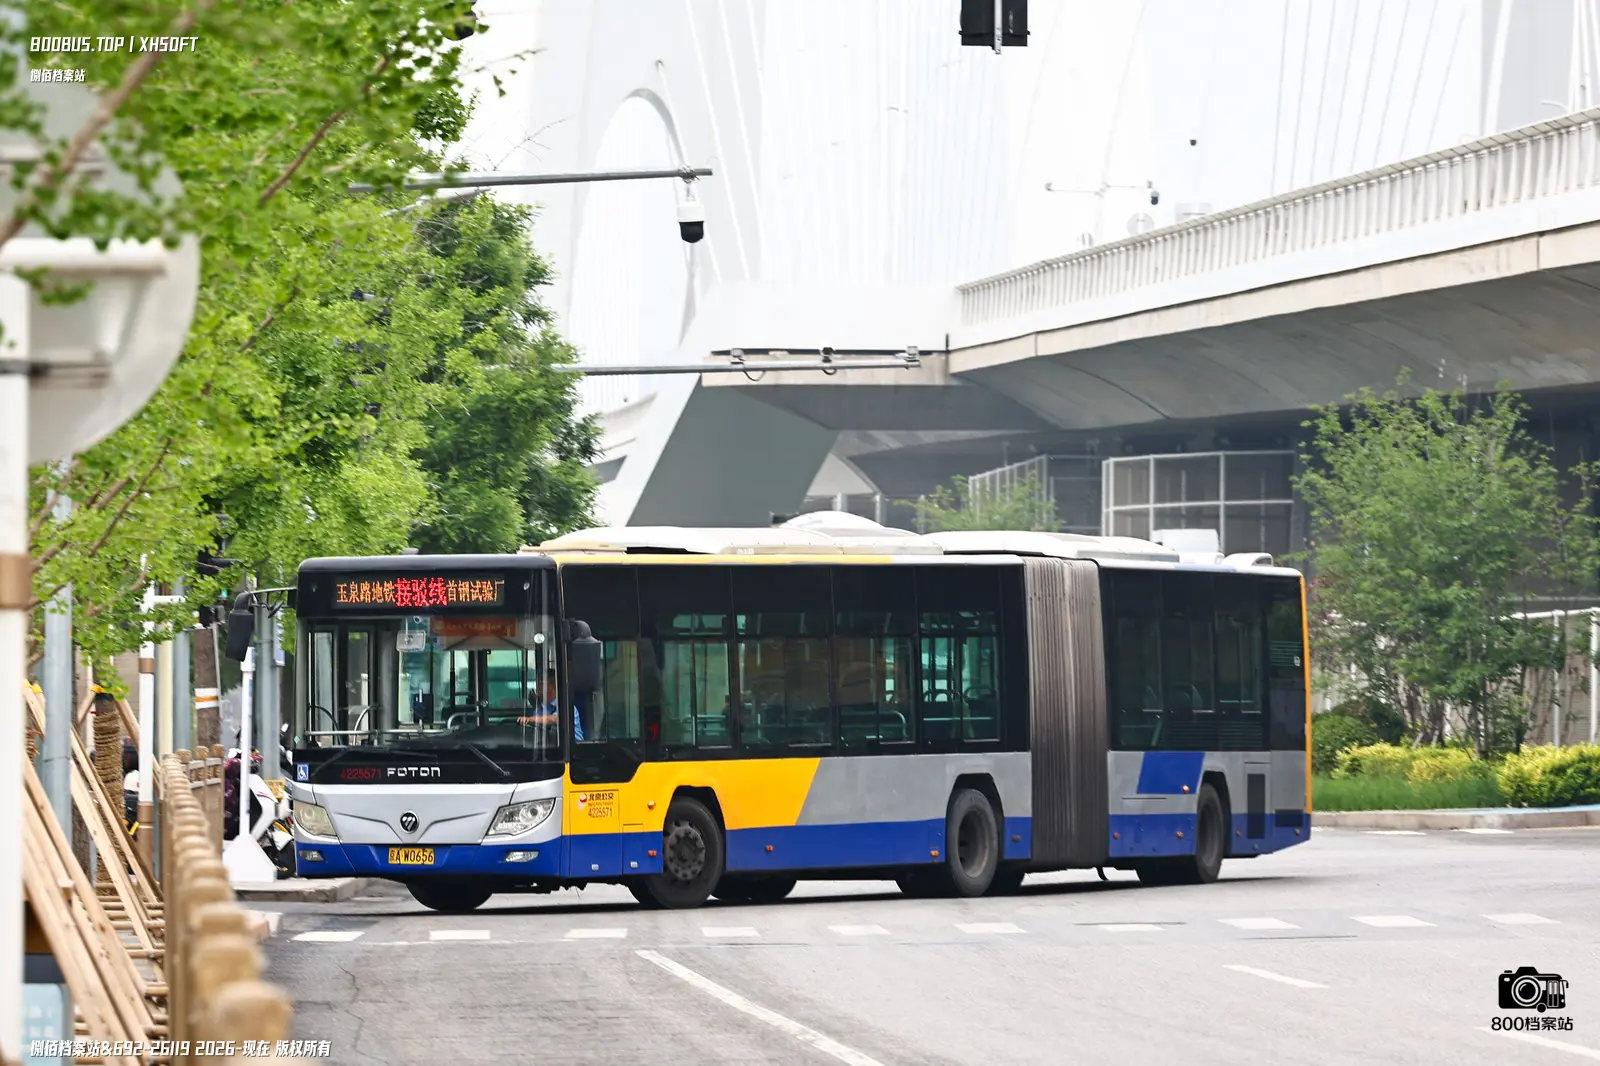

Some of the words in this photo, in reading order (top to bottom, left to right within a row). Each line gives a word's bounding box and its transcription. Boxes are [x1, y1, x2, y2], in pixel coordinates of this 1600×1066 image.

[340, 767, 382, 780] 4225571
[387, 766, 441, 778] FOTON
[588, 807, 613, 819] 4225571
